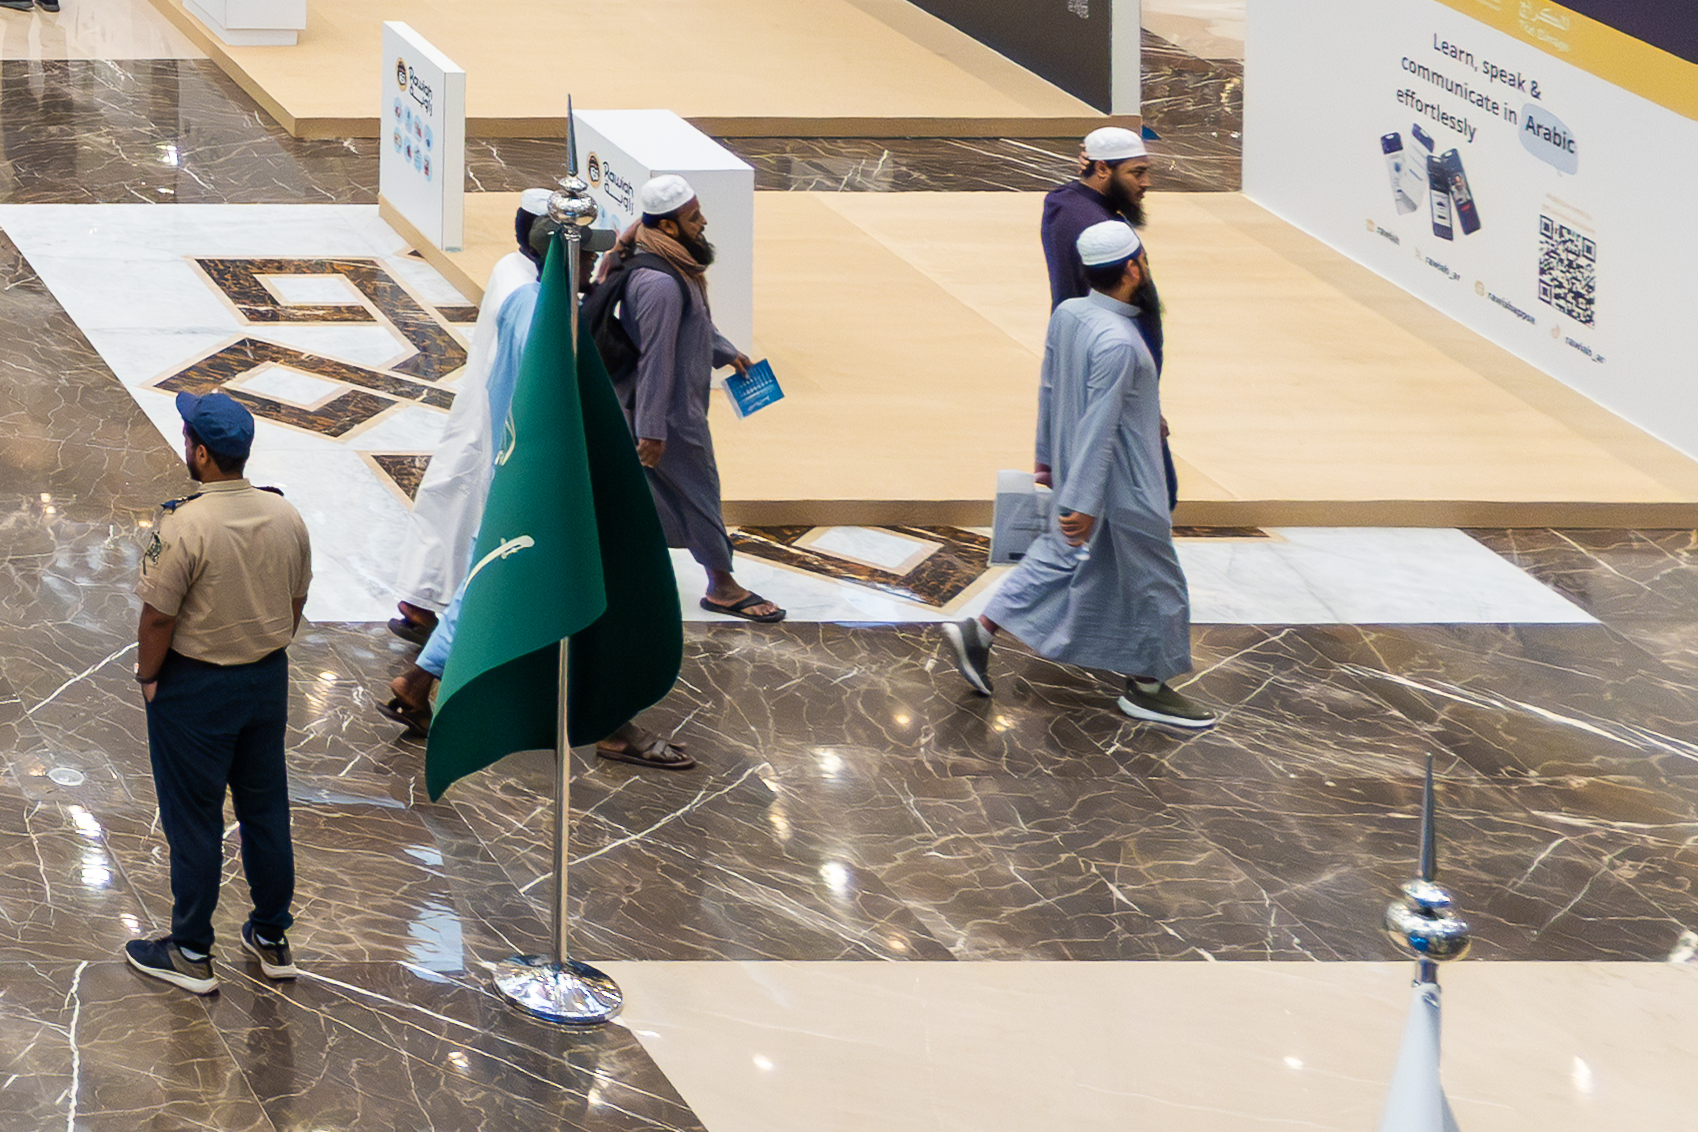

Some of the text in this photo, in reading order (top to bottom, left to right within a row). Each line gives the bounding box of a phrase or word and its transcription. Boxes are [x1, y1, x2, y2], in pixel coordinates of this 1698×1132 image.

[409, 66, 433, 99] Rawiah
[1433, 32, 1541, 100] Learn, speak &
[1395, 88, 1477, 143] effortlessly
[1400, 56, 1575, 154] communicate in Arabic
[603, 161, 634, 198] Rawiah
